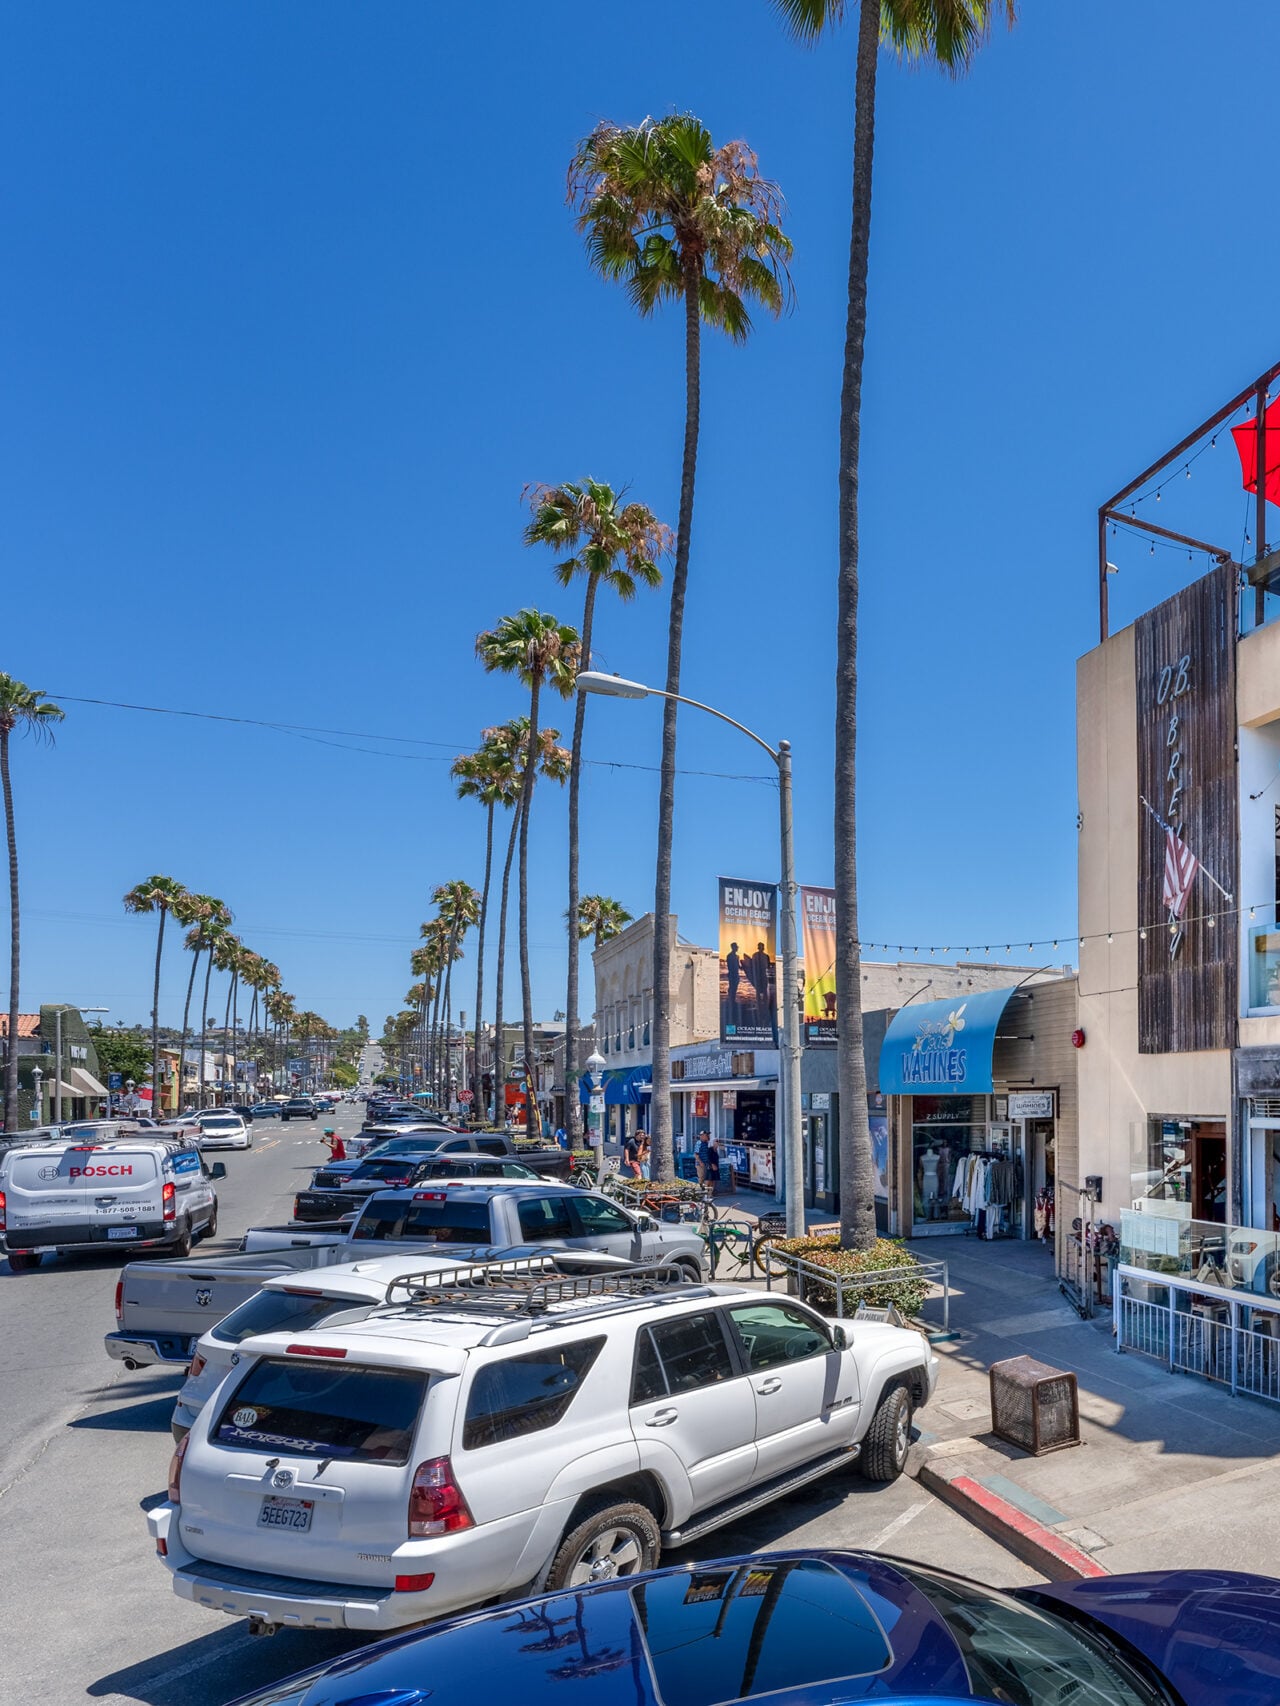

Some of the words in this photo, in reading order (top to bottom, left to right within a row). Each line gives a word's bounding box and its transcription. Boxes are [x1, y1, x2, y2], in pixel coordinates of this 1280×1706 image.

[724, 887, 772, 910] ENJOY
[806, 894, 836, 914] ENJ
[724, 906, 748, 918] OCEAN
[749, 910, 771, 921] BEACH
[901, 1048, 967, 1084] WAHINES
[69, 1165, 133, 1178] BOSCH
[235, 1411, 255, 1425] BAJA
[260, 1506, 309, 1528] 5EEG723
